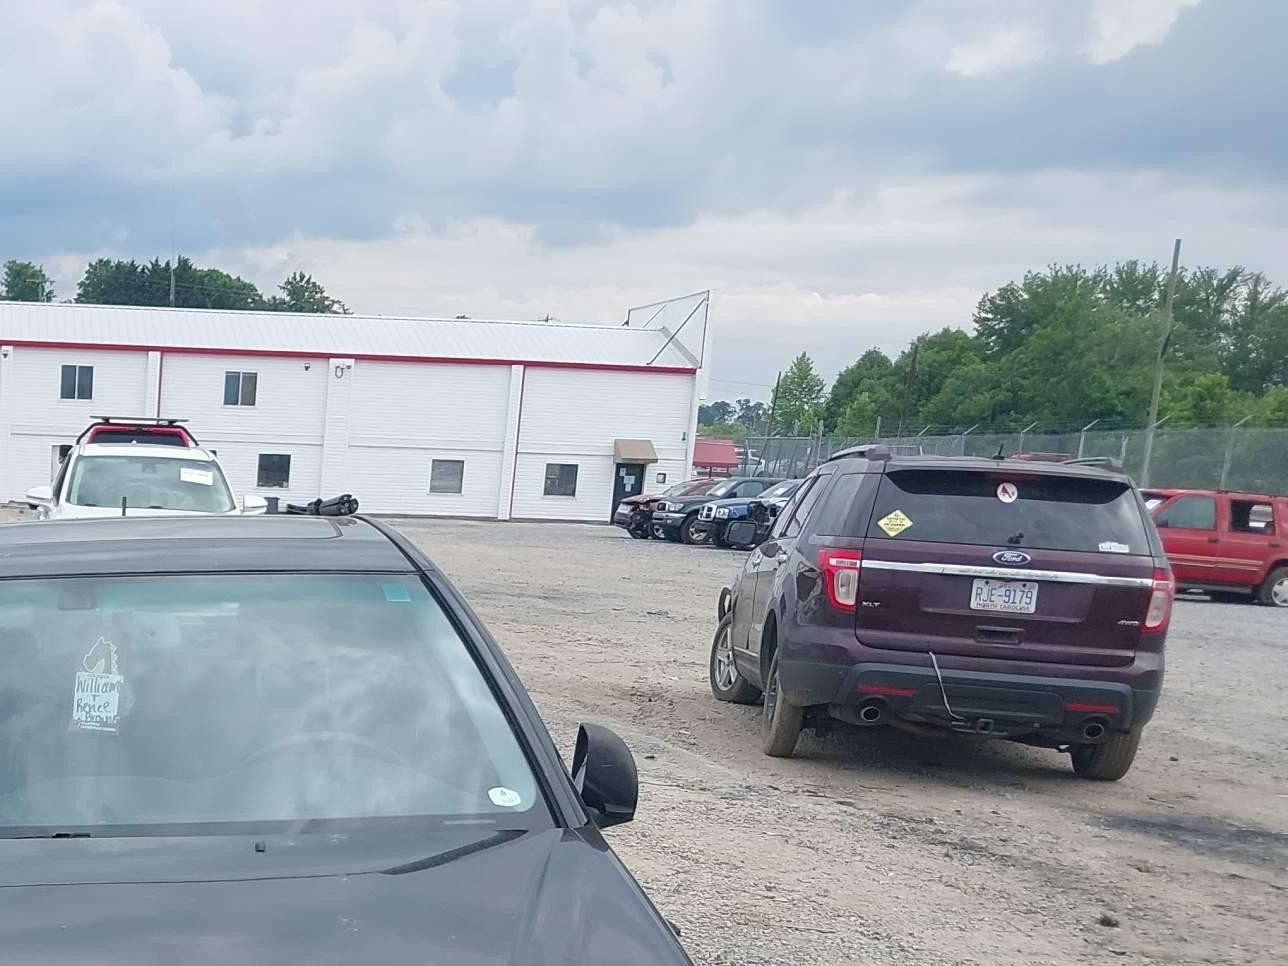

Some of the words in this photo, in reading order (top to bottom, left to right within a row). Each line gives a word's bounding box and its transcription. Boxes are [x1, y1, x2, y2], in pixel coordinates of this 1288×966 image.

[974, 586, 1033, 606] RJE-9179
[76, 674, 120, 694] William
[76, 698, 111, 714] Renee
